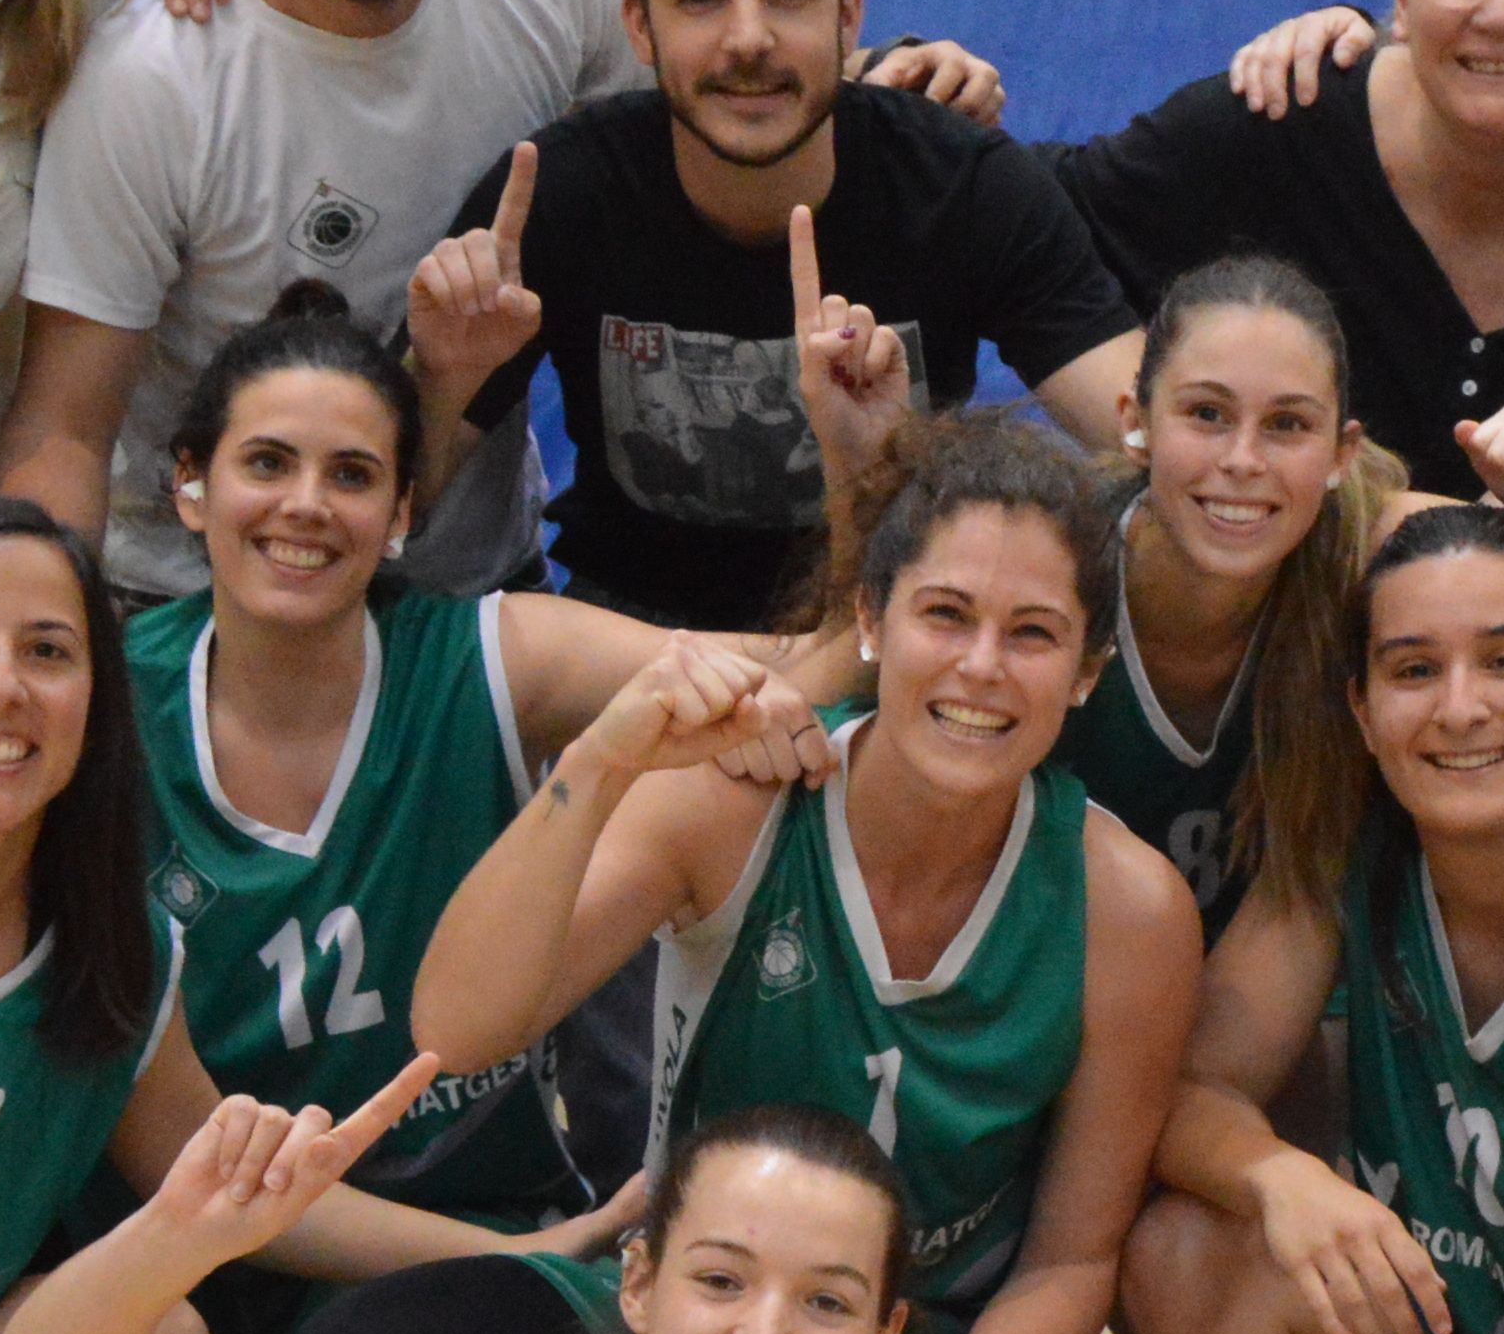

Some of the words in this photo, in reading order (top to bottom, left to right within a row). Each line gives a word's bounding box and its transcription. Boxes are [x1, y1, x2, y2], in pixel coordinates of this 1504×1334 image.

[606, 320, 660, 360] LIFE
[1167, 808, 1221, 908] 8
[256, 904, 387, 1049] 12
[864, 1045, 903, 1160] 1
